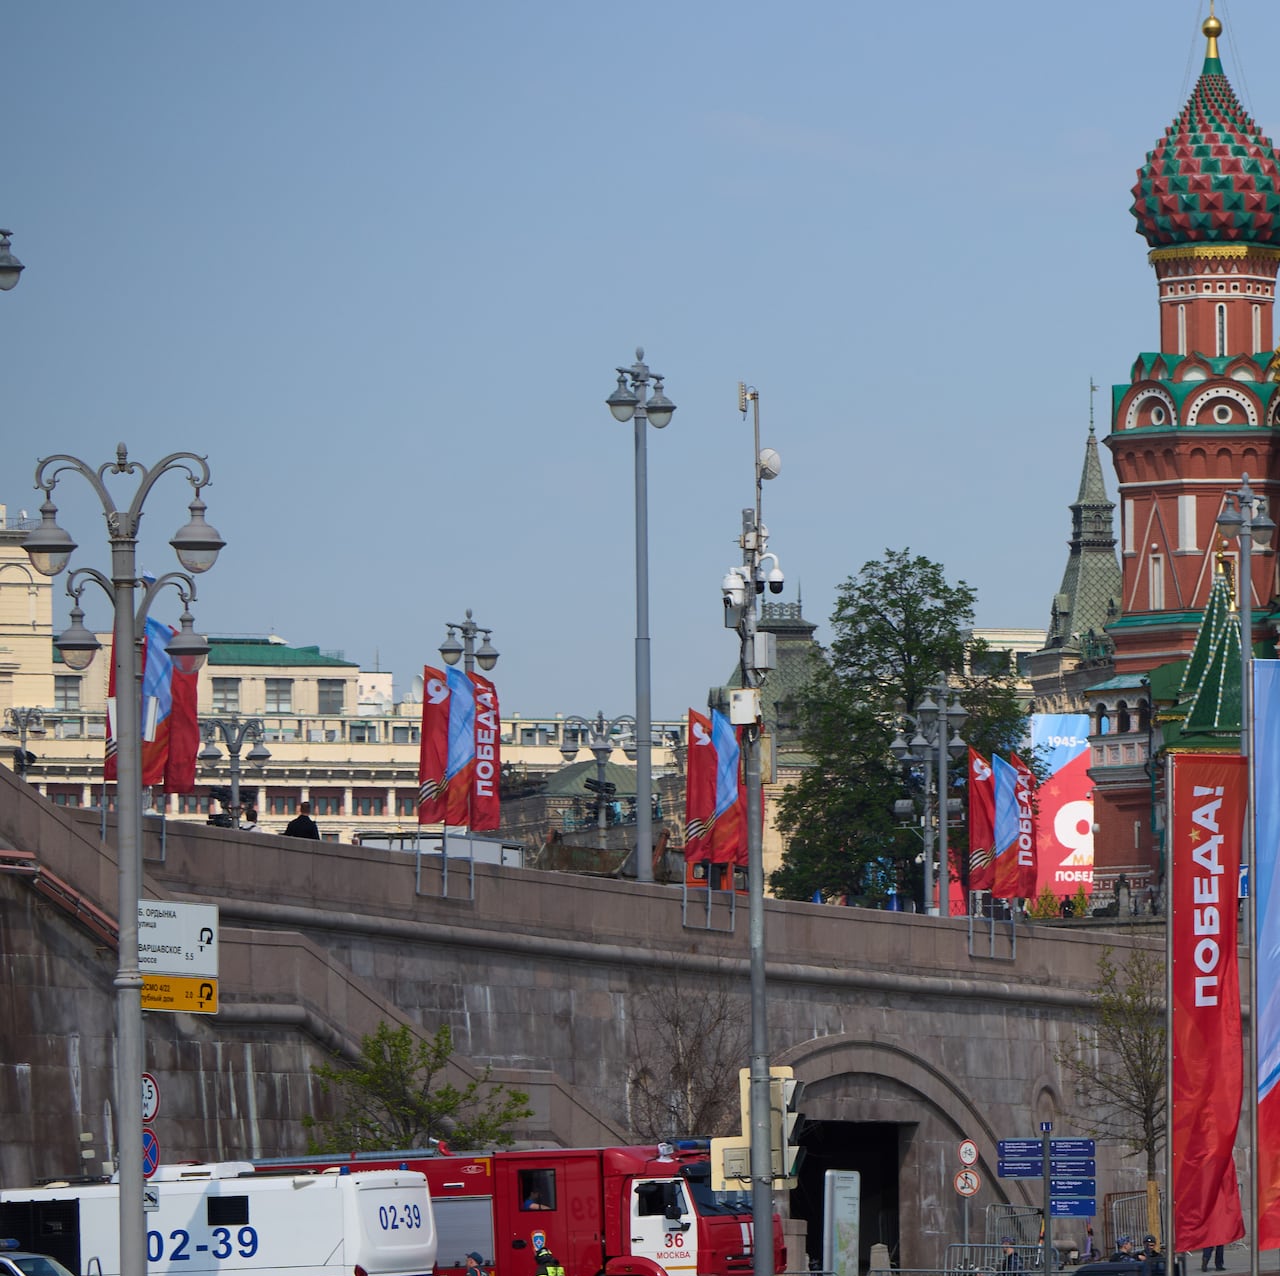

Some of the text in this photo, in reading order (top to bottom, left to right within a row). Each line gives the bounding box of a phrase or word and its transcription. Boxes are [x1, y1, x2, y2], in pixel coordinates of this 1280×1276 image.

[427, 678, 450, 704] 9
[475, 682, 498, 797] ПОБЕДА!
[973, 758, 992, 781] 9
[1054, 800, 1094, 866] 9
[1191, 785, 1225, 1008] ПОБЕДА!
[146, 908, 177, 919] ОРДЫНКА
[138, 944, 182, 955] ВАРШАВСКОЕ
[185, 953, 194, 961] 5.5
[379, 1204, 421, 1231] 02-39
[147, 1226, 259, 1262] 02-39
[664, 1233, 684, 1248] 36
[656, 1251, 690, 1260] МОСКВА
